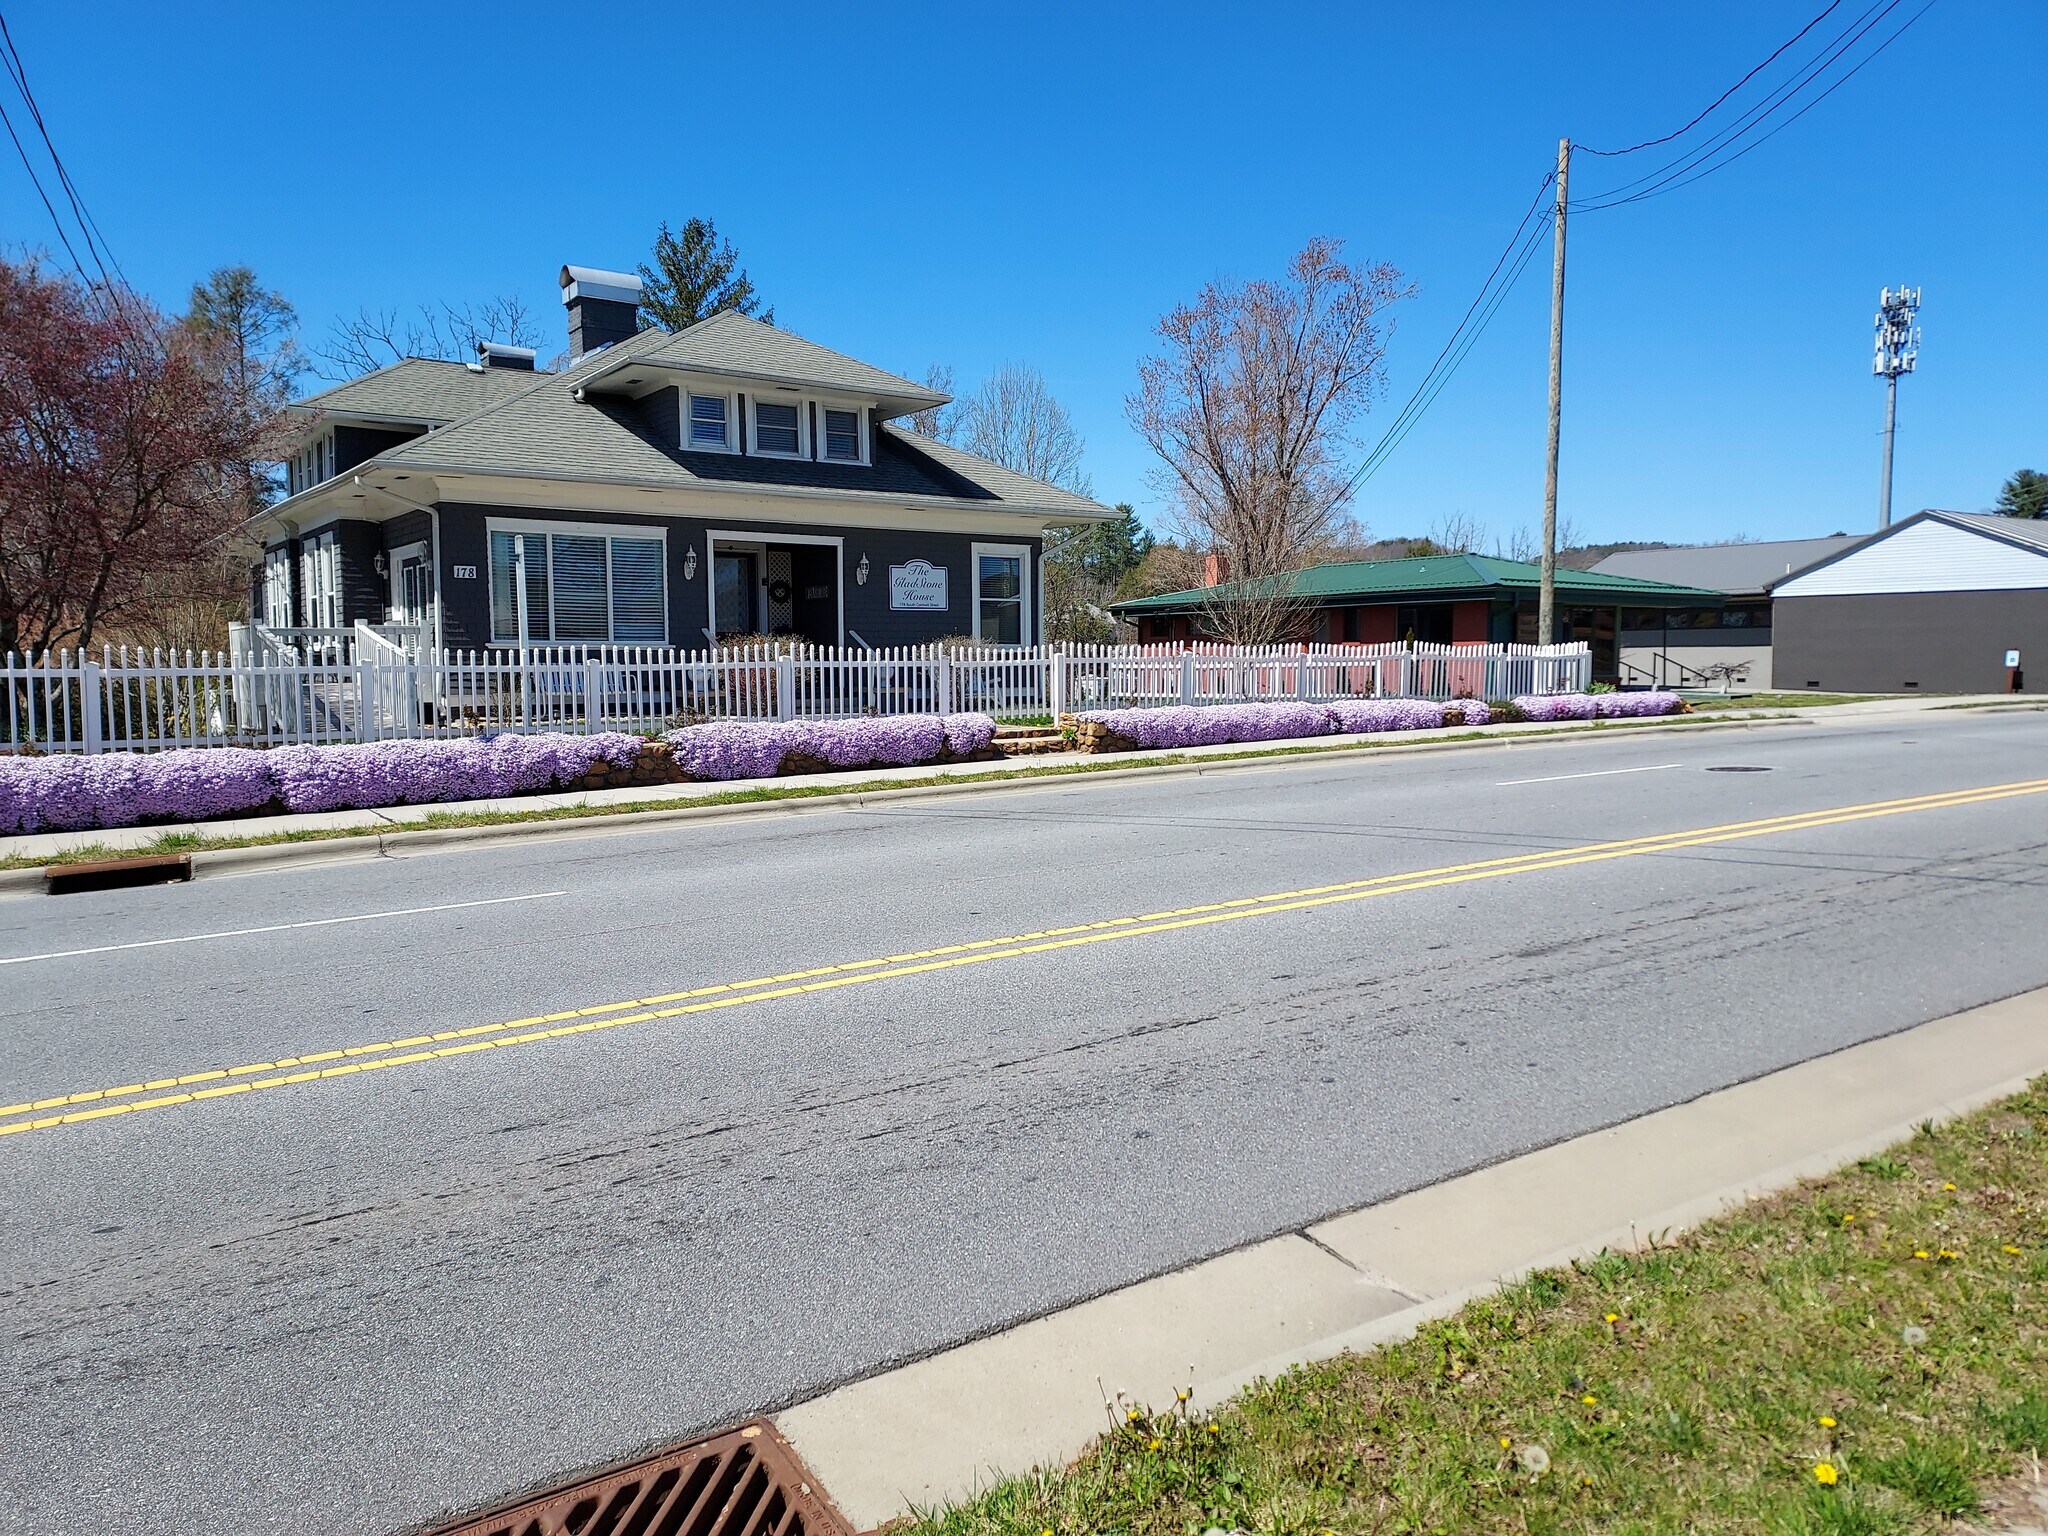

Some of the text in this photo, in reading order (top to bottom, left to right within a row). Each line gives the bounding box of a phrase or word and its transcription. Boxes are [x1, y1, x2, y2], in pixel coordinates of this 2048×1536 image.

[456, 567, 475, 578] 178
[908, 564, 930, 576] The
[902, 589, 935, 601] House
